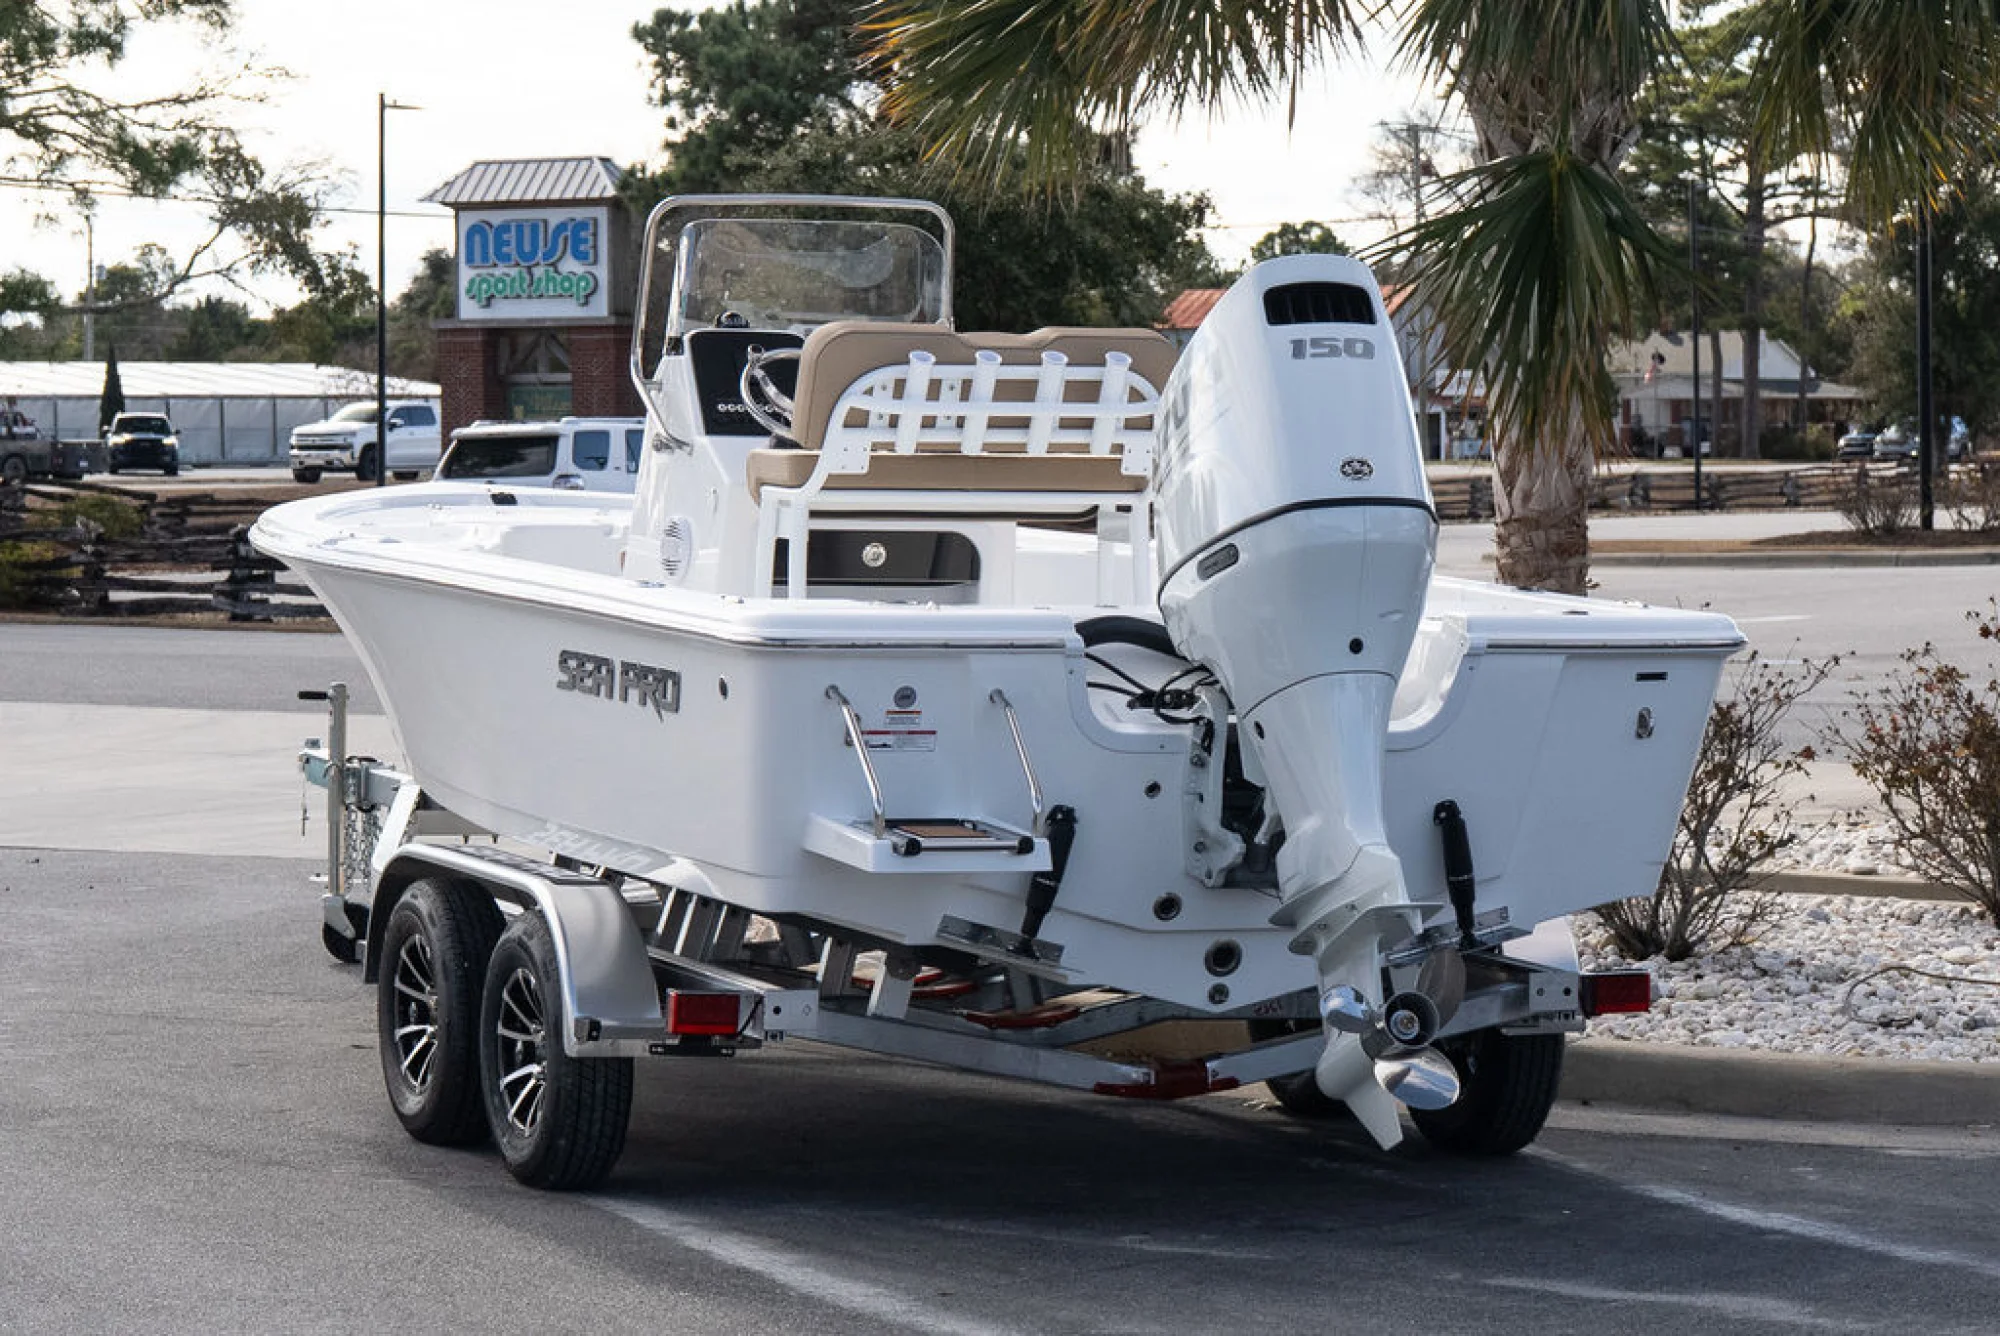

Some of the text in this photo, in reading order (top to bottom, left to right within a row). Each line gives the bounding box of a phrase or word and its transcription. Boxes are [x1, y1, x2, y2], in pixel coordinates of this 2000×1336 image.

[465, 219, 596, 266] NEUSE
[465, 268, 594, 305] sport shop
[1289, 337, 1375, 360] 150
[556, 649, 682, 722] SEA PRO
